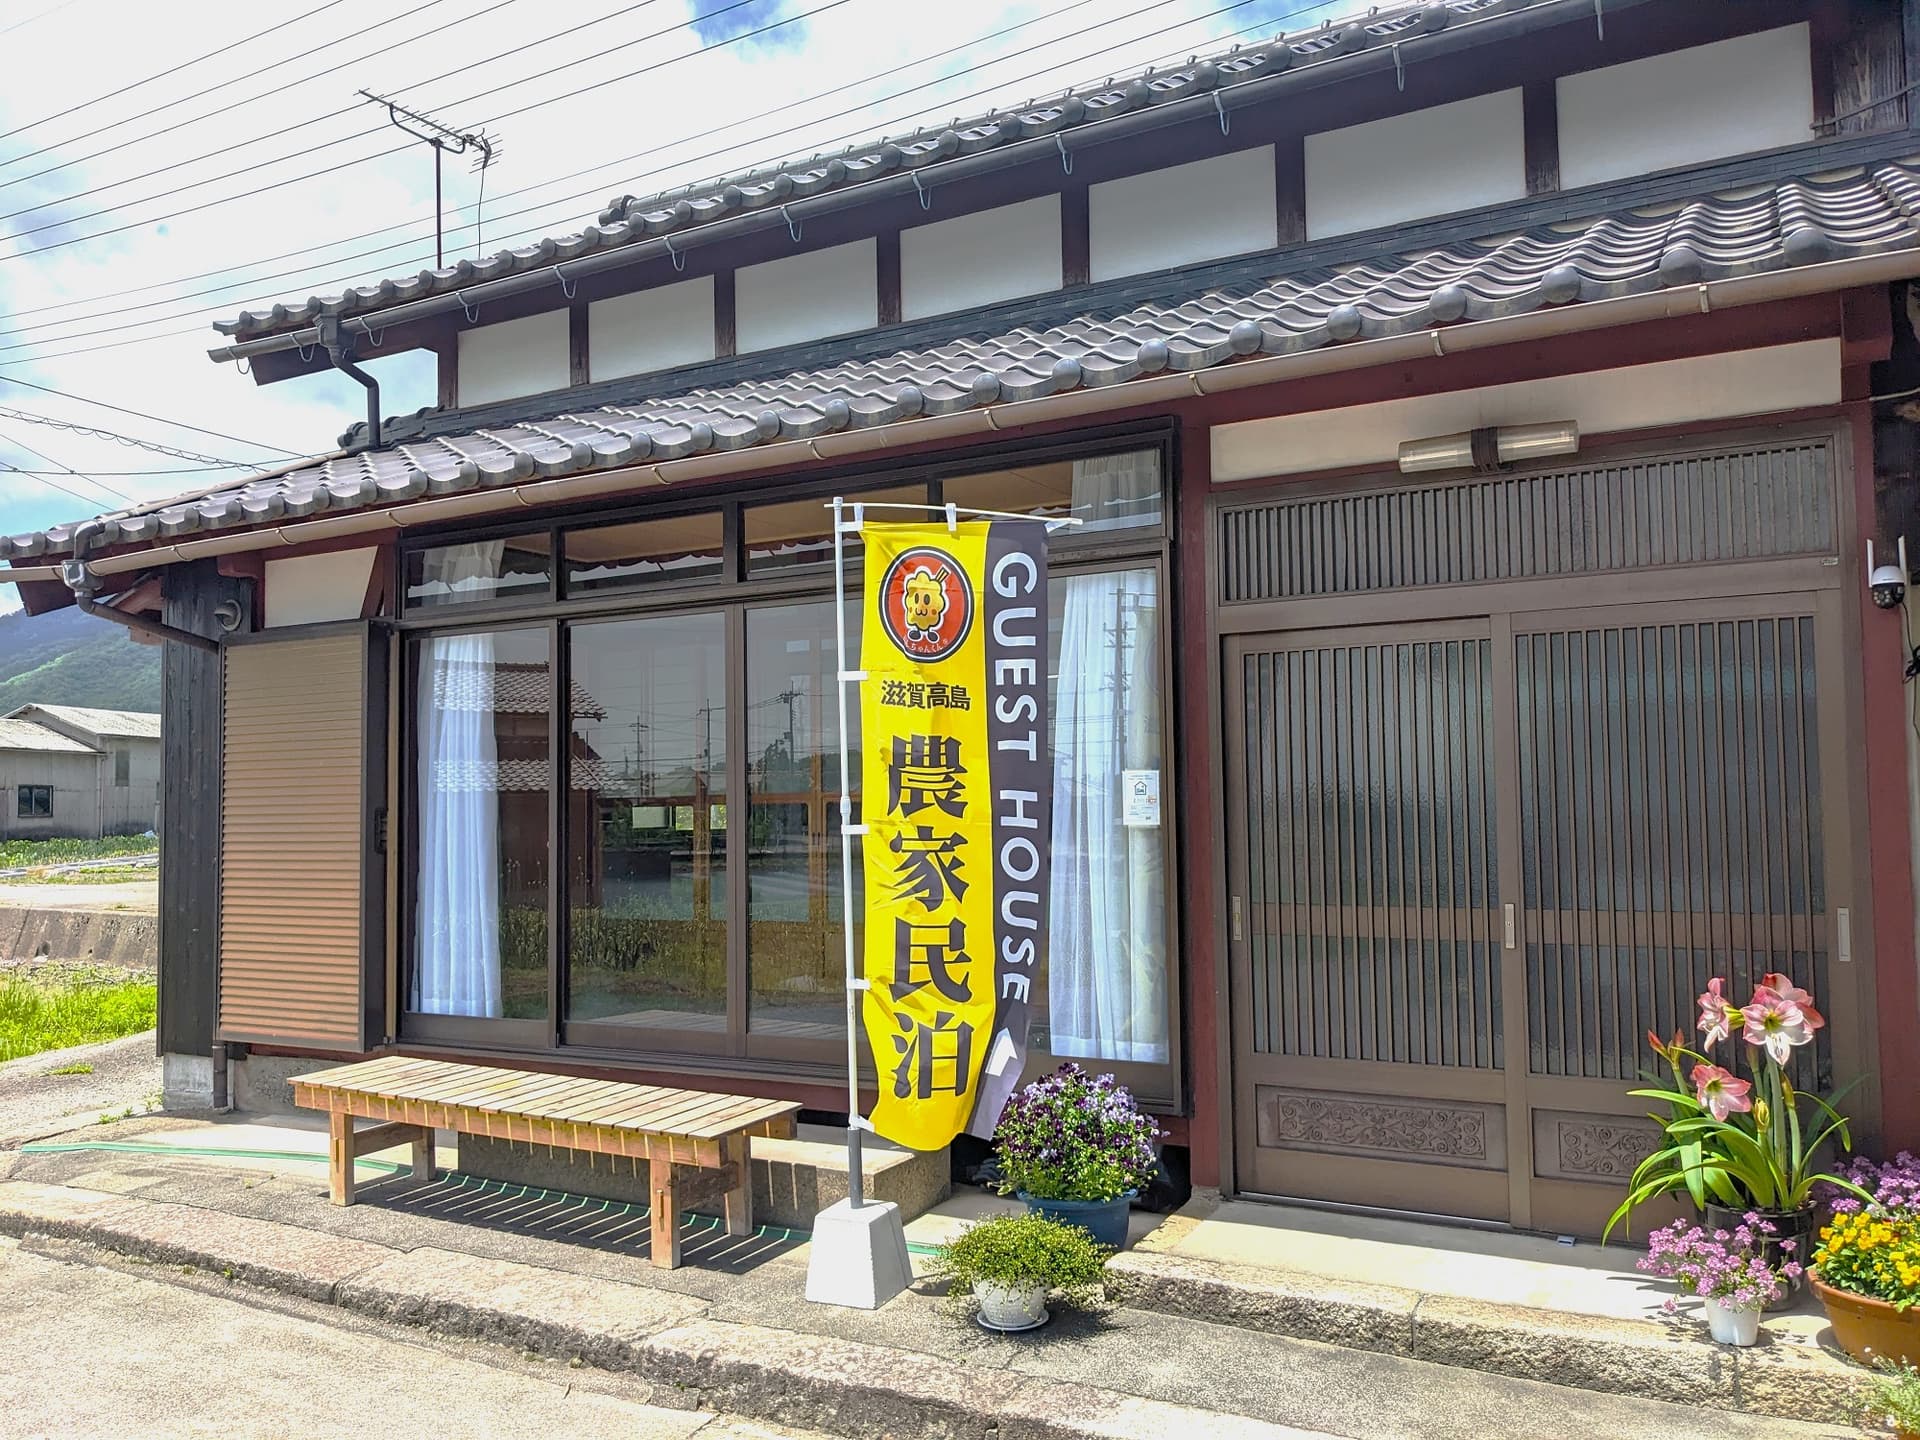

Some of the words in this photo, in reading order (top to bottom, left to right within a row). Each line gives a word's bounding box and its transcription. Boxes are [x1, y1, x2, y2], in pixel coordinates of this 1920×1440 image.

[881, 680, 971, 711] 滋賀高島
[992, 552, 1038, 762] GUEST
[887, 734, 974, 1100] 農家民泊
[1000, 789, 1040, 1005] HOUSE
